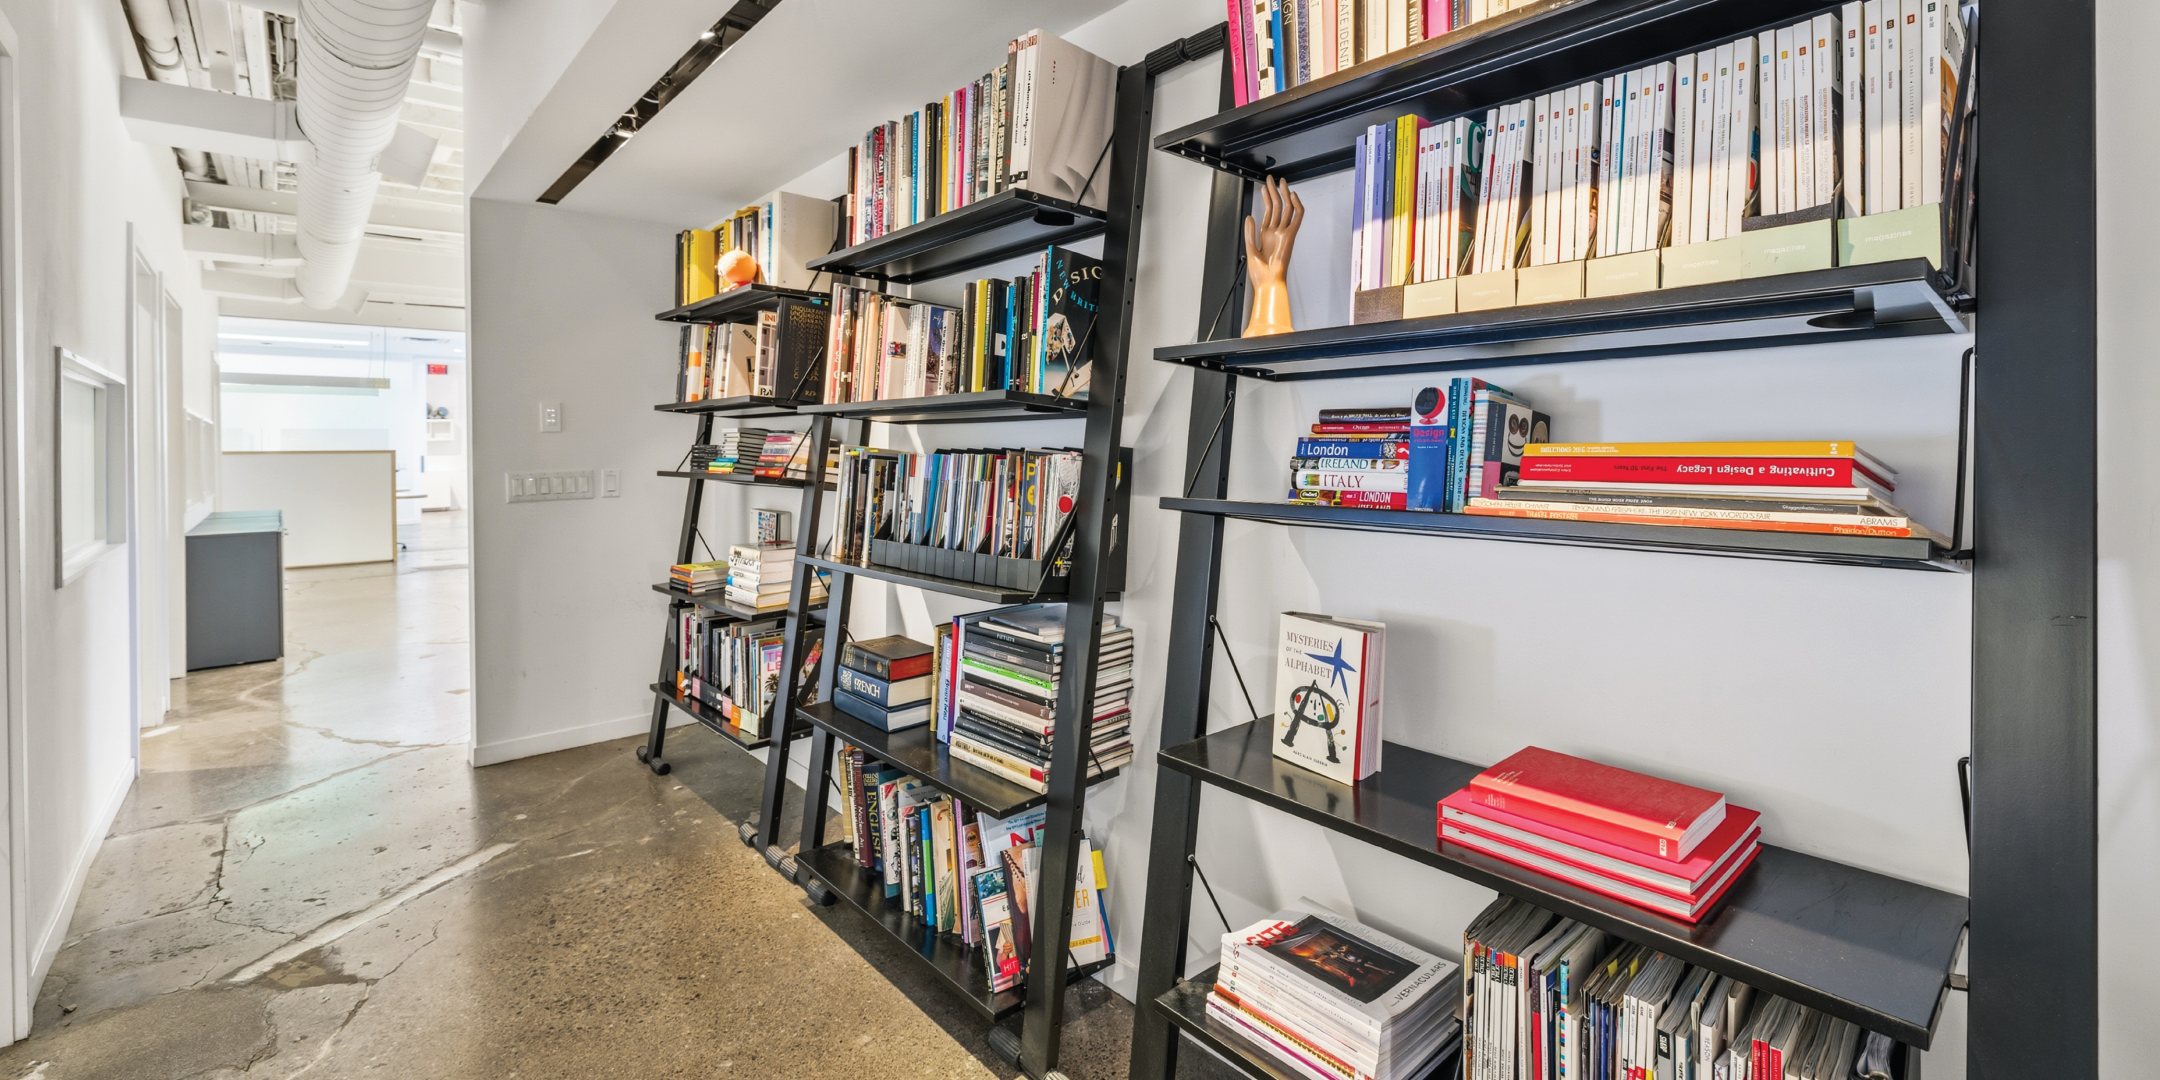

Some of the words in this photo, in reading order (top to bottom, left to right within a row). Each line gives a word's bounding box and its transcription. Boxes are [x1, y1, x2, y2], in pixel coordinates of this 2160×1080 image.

[1864, 228, 1913, 244] magazines
[1412, 427, 1445, 439] Design
[1307, 443, 1349, 457] London
[1320, 458, 1369, 470] IRELAND
[1676, 463, 1713, 476] Legacy
[1716, 463, 1755, 476] Design
[1769, 463, 1836, 477] Cultivating
[1323, 474, 1365, 488] ITALY
[1359, 492, 1392, 504] LONDON
[1859, 517, 1898, 527] ABRAMS
[1833, 526, 1897, 537] Phaidon/Dutton
[1286, 631, 1334, 653] MYSTERIES
[1284, 657, 1333, 679] ALPHABET
[853, 677, 880, 699] FRENCH
[866, 791, 882, 859] ENGLISH
[1246, 921, 1300, 949] SITE
[1003, 961, 1017, 973] HIT
[1395, 961, 1447, 1002] VERNACULARS
